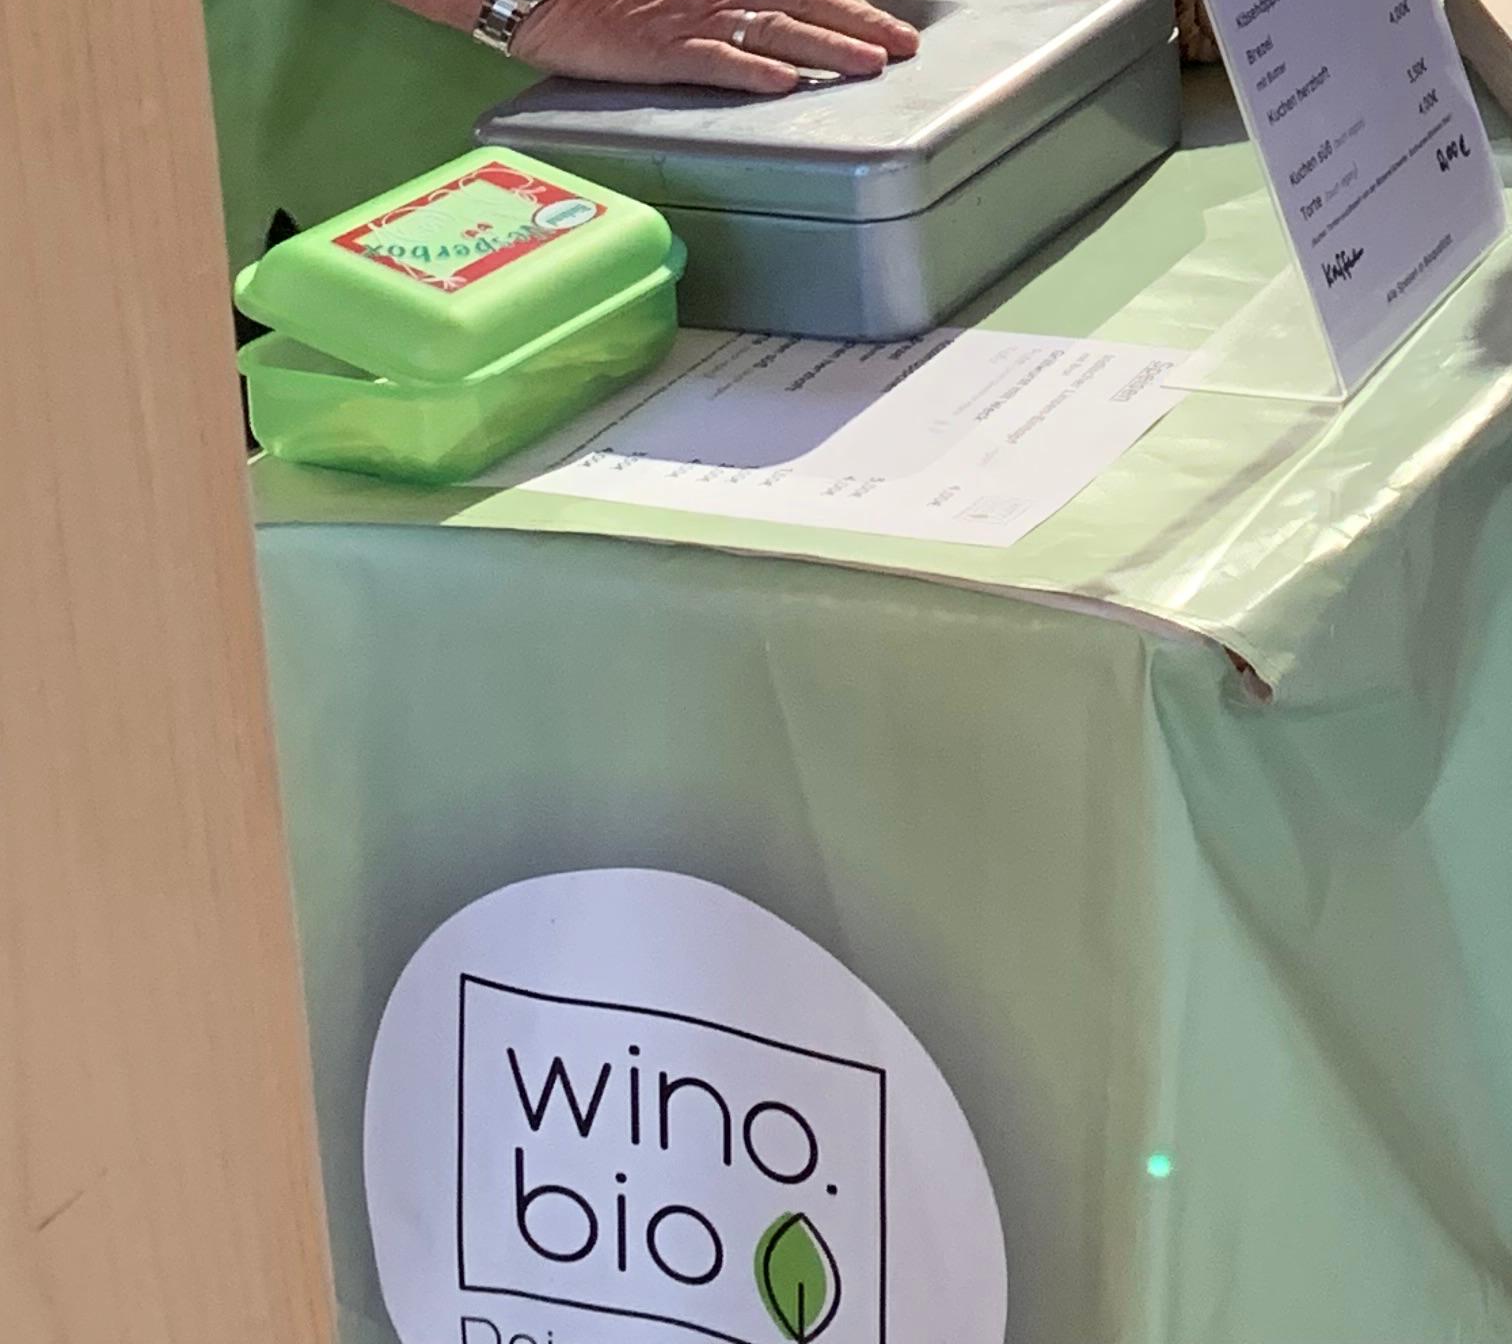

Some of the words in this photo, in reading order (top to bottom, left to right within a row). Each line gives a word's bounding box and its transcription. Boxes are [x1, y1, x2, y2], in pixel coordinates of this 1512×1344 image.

[1265, 90, 1298, 127] Kuchen
[1288, 152, 1319, 188] Kuchen
[1299, 192, 1324, 223] Torte
[515, 1146, 724, 1286] bio
